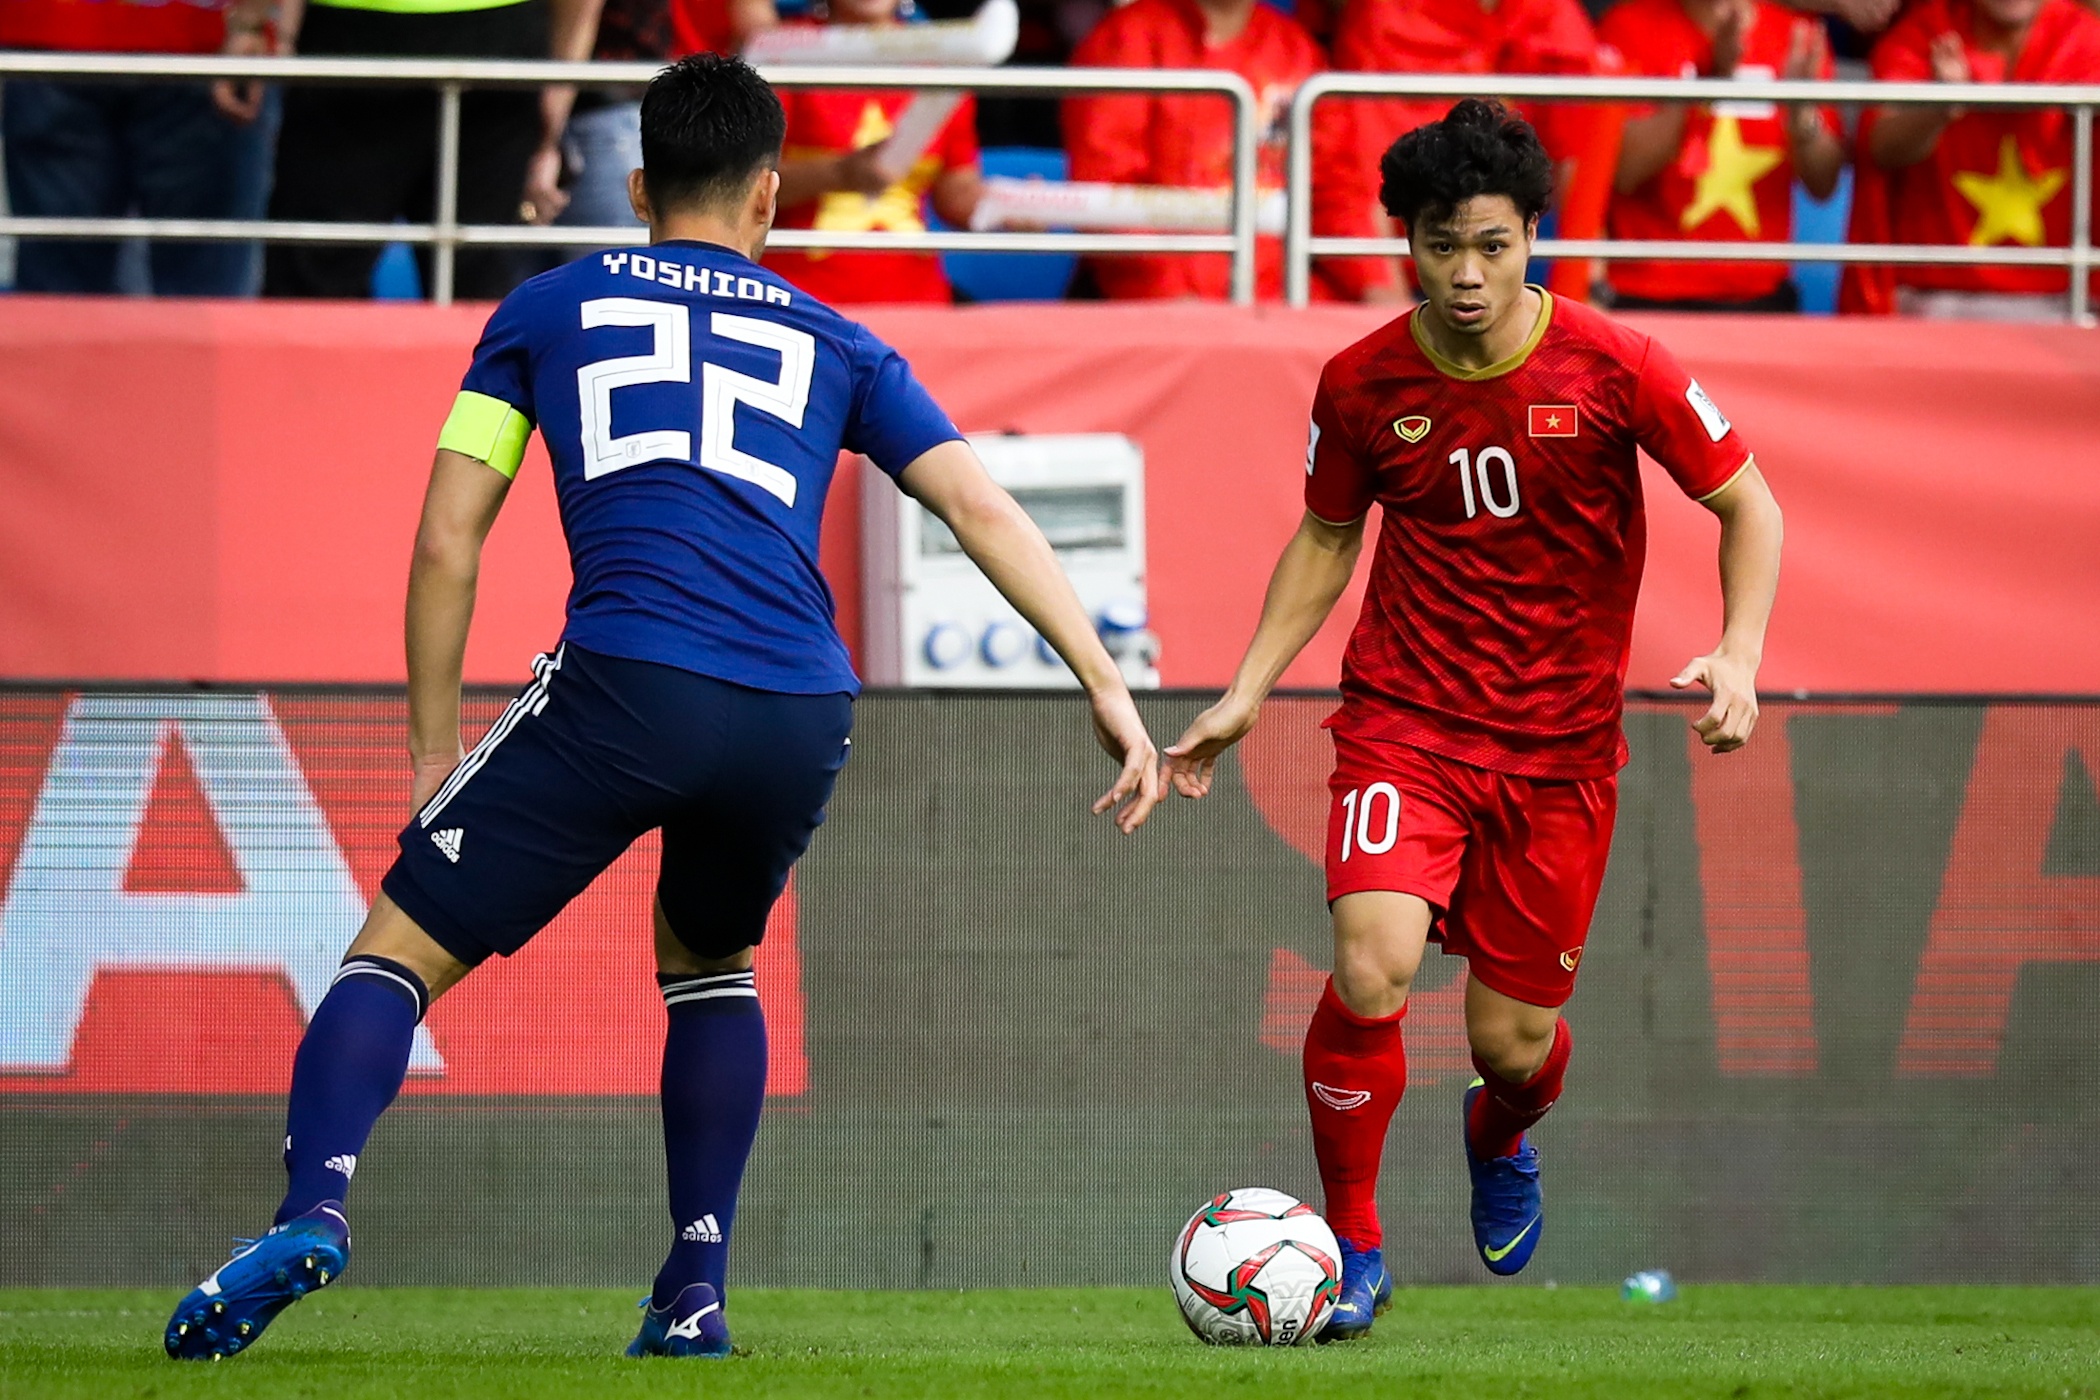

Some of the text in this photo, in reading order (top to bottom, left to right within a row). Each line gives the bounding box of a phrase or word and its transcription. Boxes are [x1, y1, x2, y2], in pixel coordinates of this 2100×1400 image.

[602, 252, 792, 307] YOSHIDA
[577, 297, 816, 509] 22
[1449, 446, 1520, 519] 10
[430, 831, 460, 863] adidas
[1341, 781, 1400, 863] 10
[681, 1231, 722, 1243] adidas
